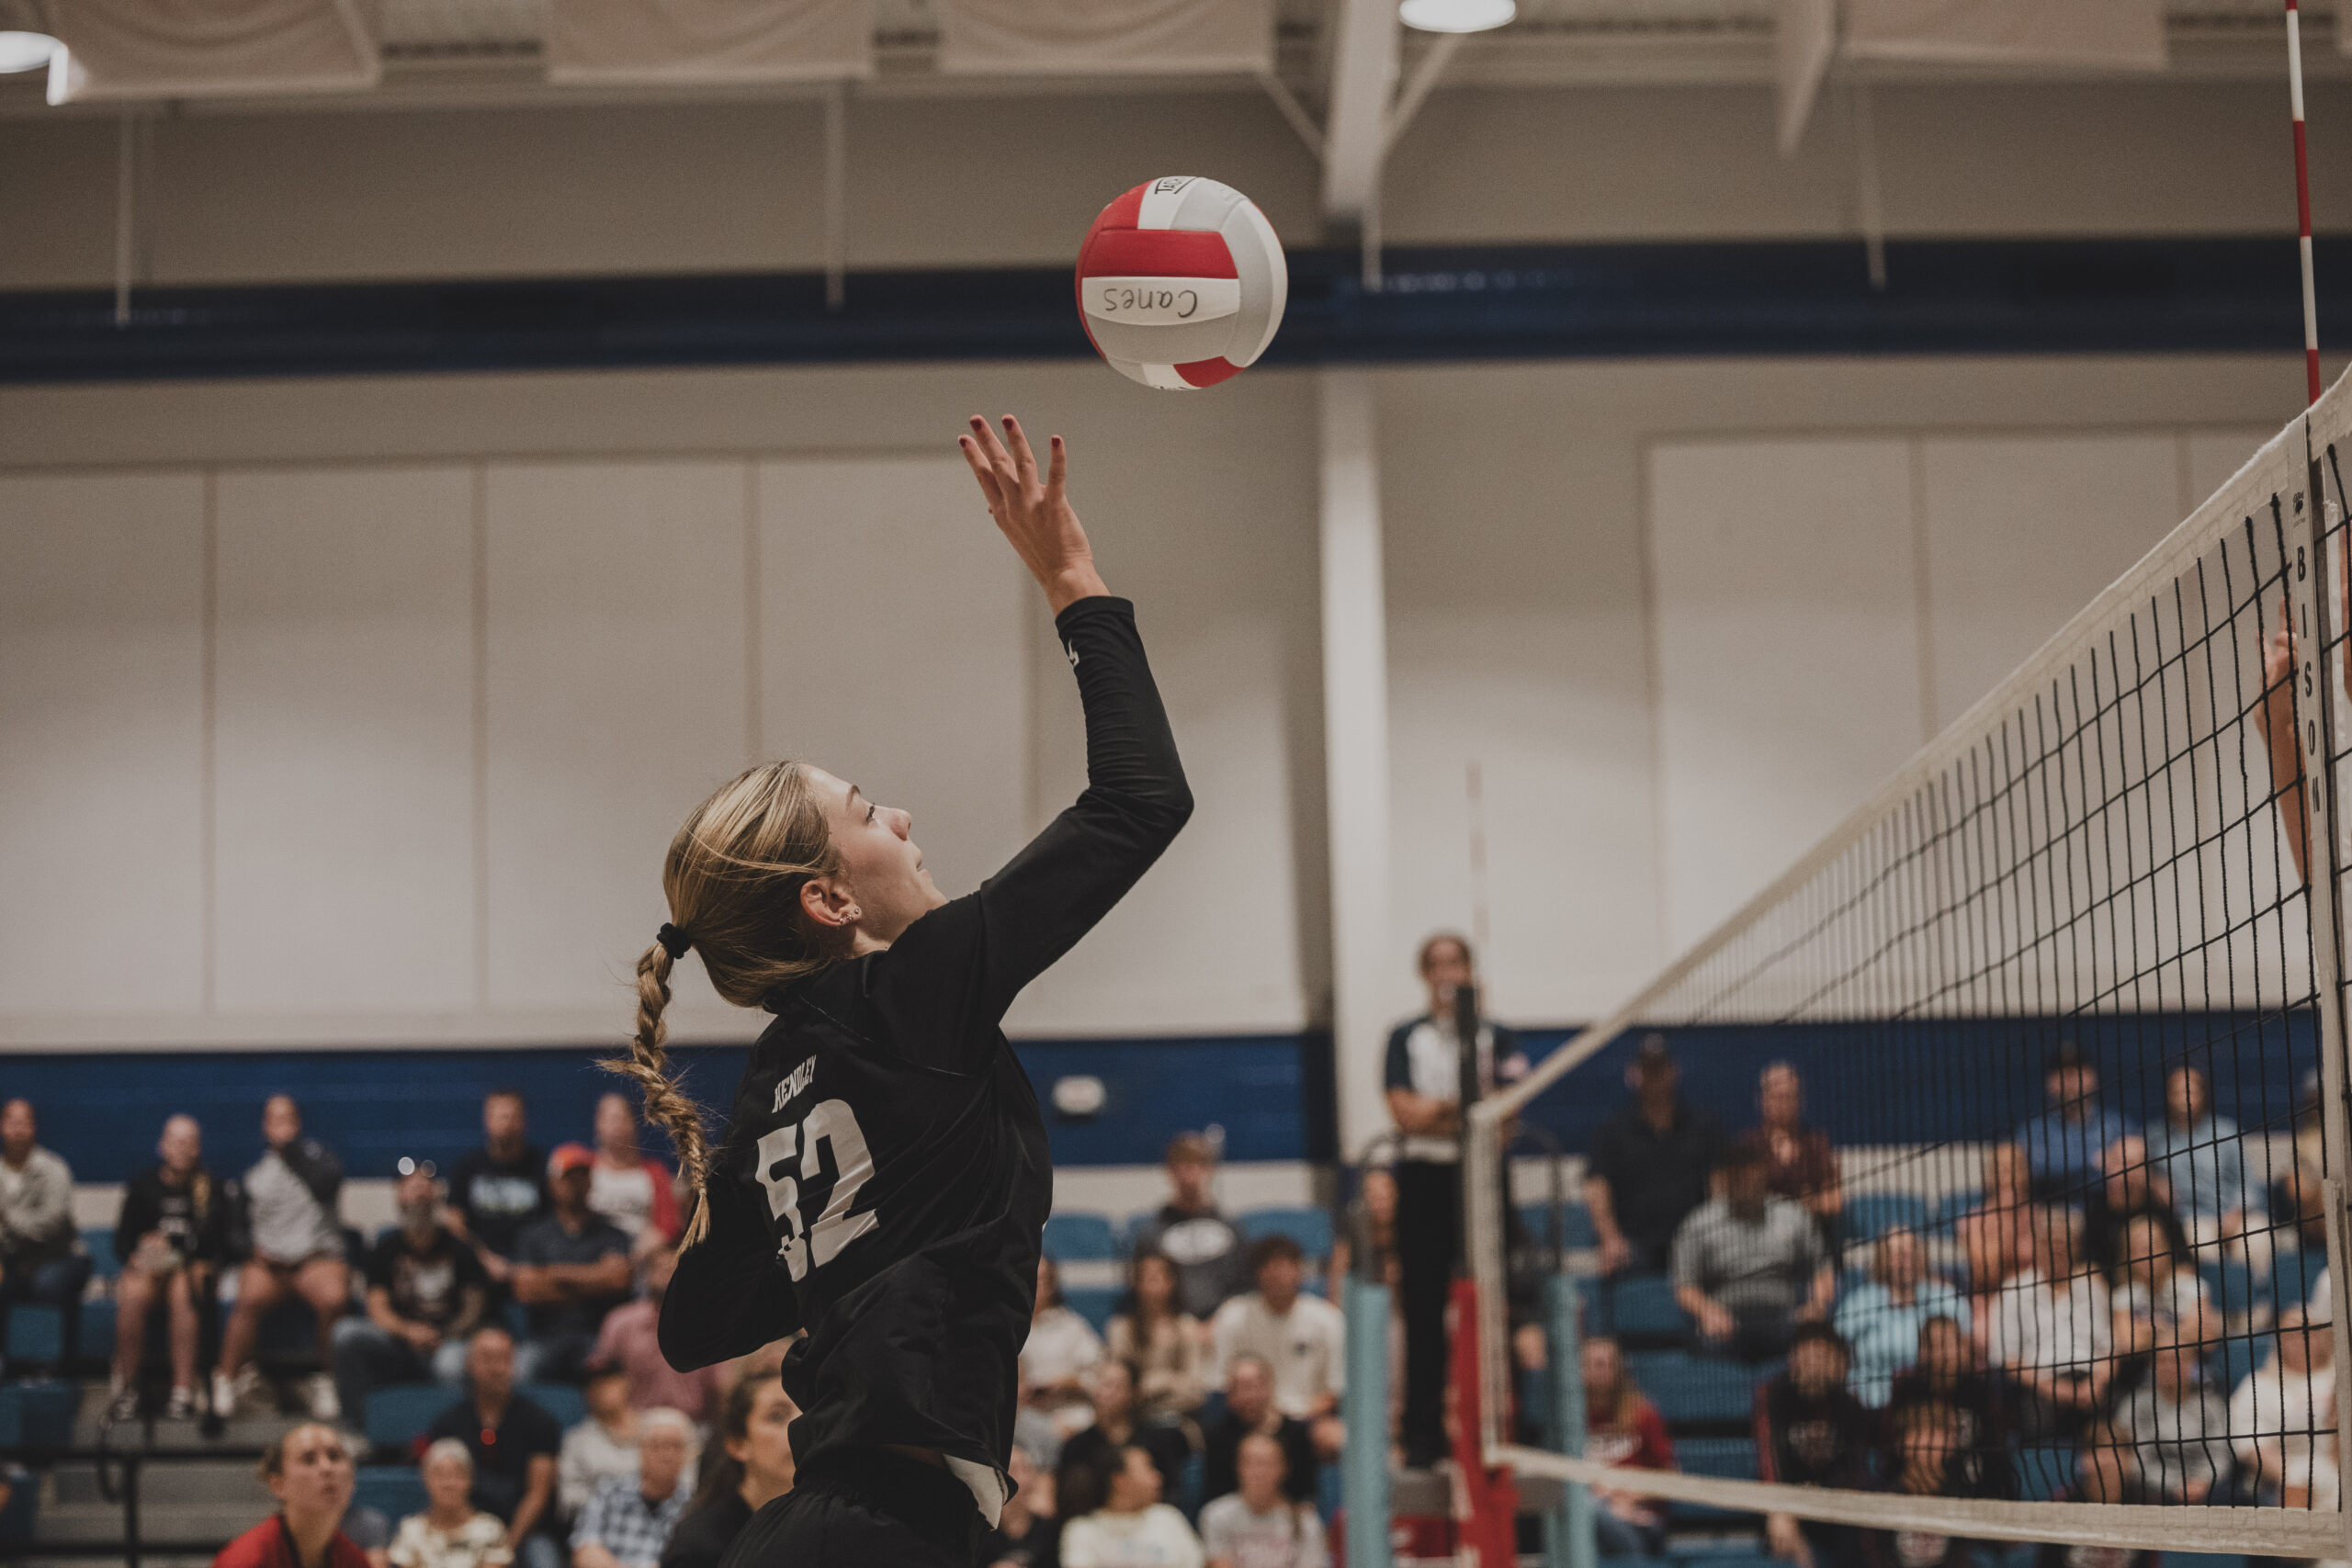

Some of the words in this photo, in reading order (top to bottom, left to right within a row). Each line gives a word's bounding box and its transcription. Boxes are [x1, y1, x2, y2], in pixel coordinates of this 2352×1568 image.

[1104, 288, 1198, 318] Canes
[2296, 545, 2321, 813] BISON
[772, 1055, 817, 1114] HENDLEY
[755, 1099, 879, 1282] 52
